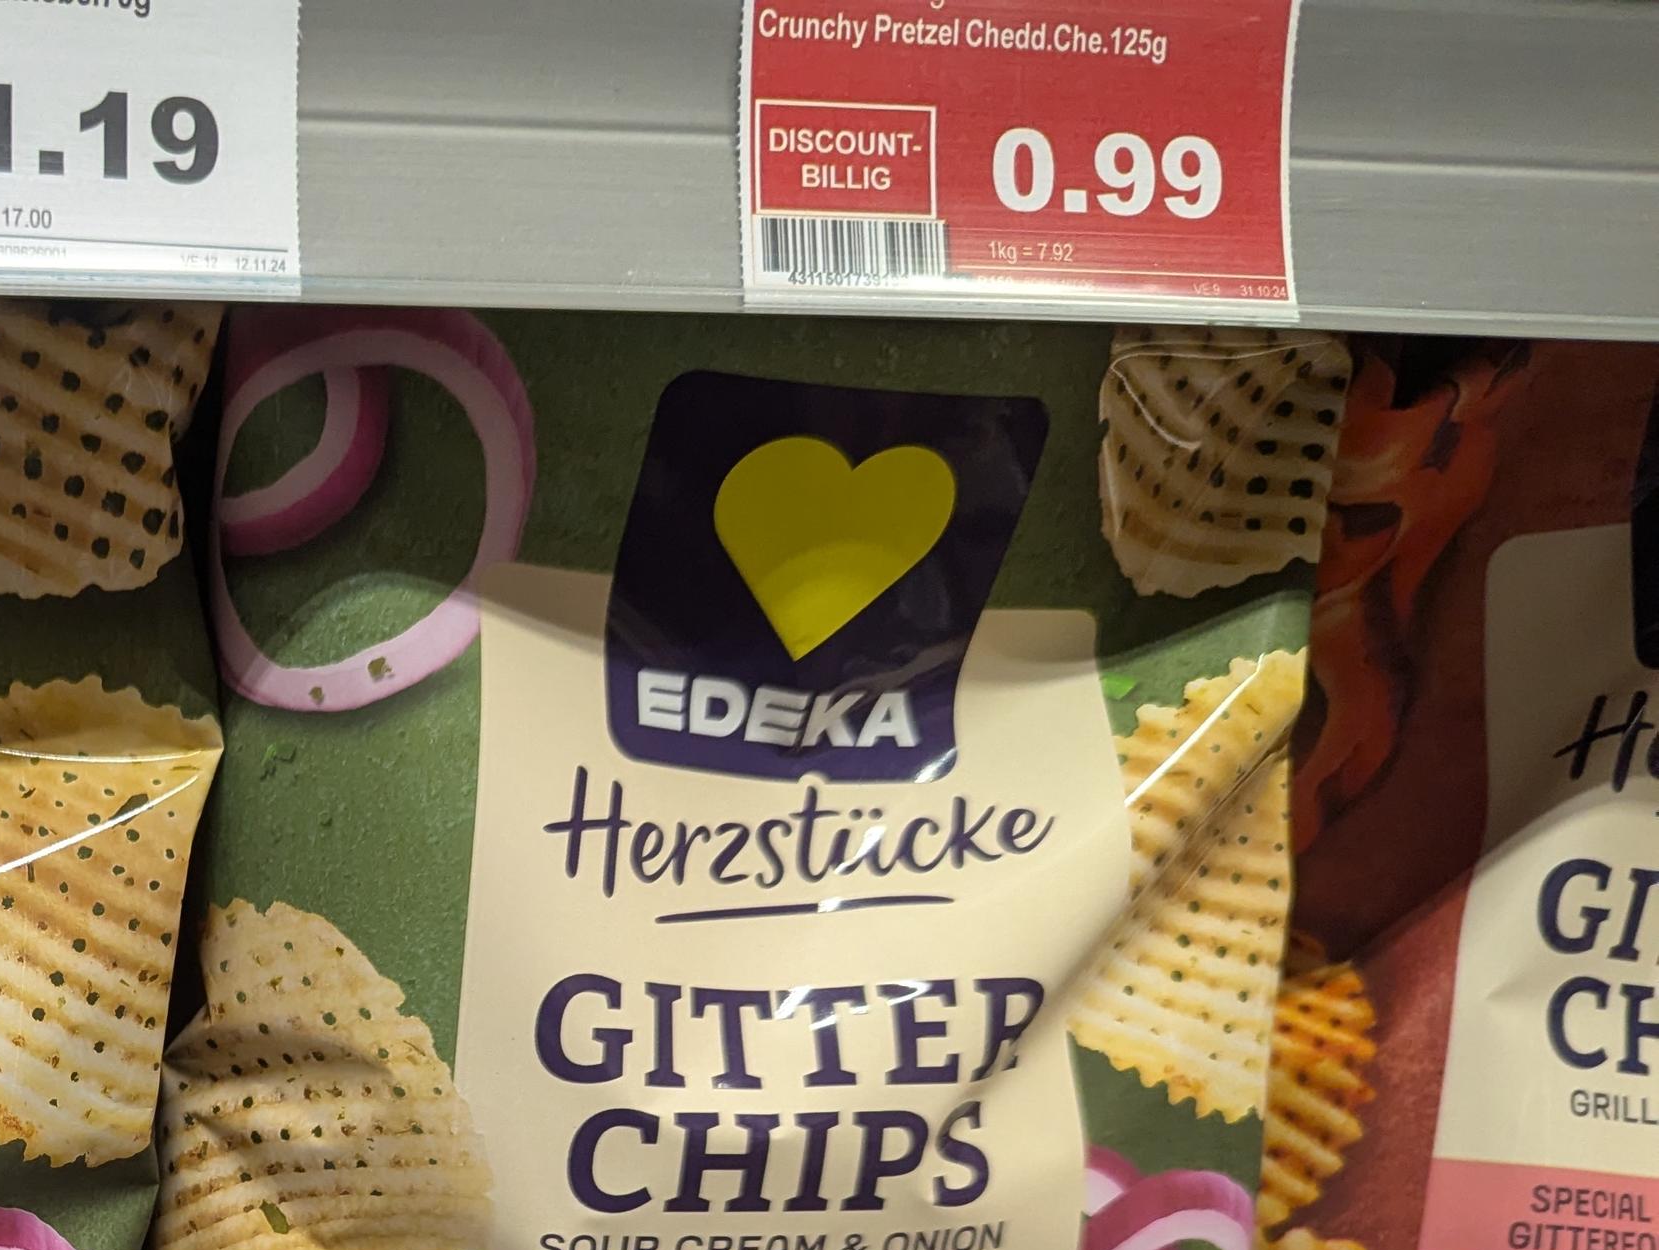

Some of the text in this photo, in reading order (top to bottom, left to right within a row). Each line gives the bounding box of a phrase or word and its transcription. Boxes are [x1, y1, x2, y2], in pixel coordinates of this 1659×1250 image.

[758, 9, 1168, 64] Crunchy Pretzel Chedd.Che.125g
[768, 128, 923, 158] DISCOUNT-
[801, 164, 892, 190] BILLIG
[992, 127, 1223, 220] 0.99
[2, 207, 53, 230] 17.00
[989, 241, 1017, 264] 1kg
[1038, 243, 1073, 262] 7.92
[637, 668, 920, 748] EDEKA
[542, 765, 1055, 899] Herzstücke
[534, 973, 1045, 1090] GITTER
[567, 1101, 990, 1214] CHIPS
[1530, 1185, 1651, 1222] SPECIAL
